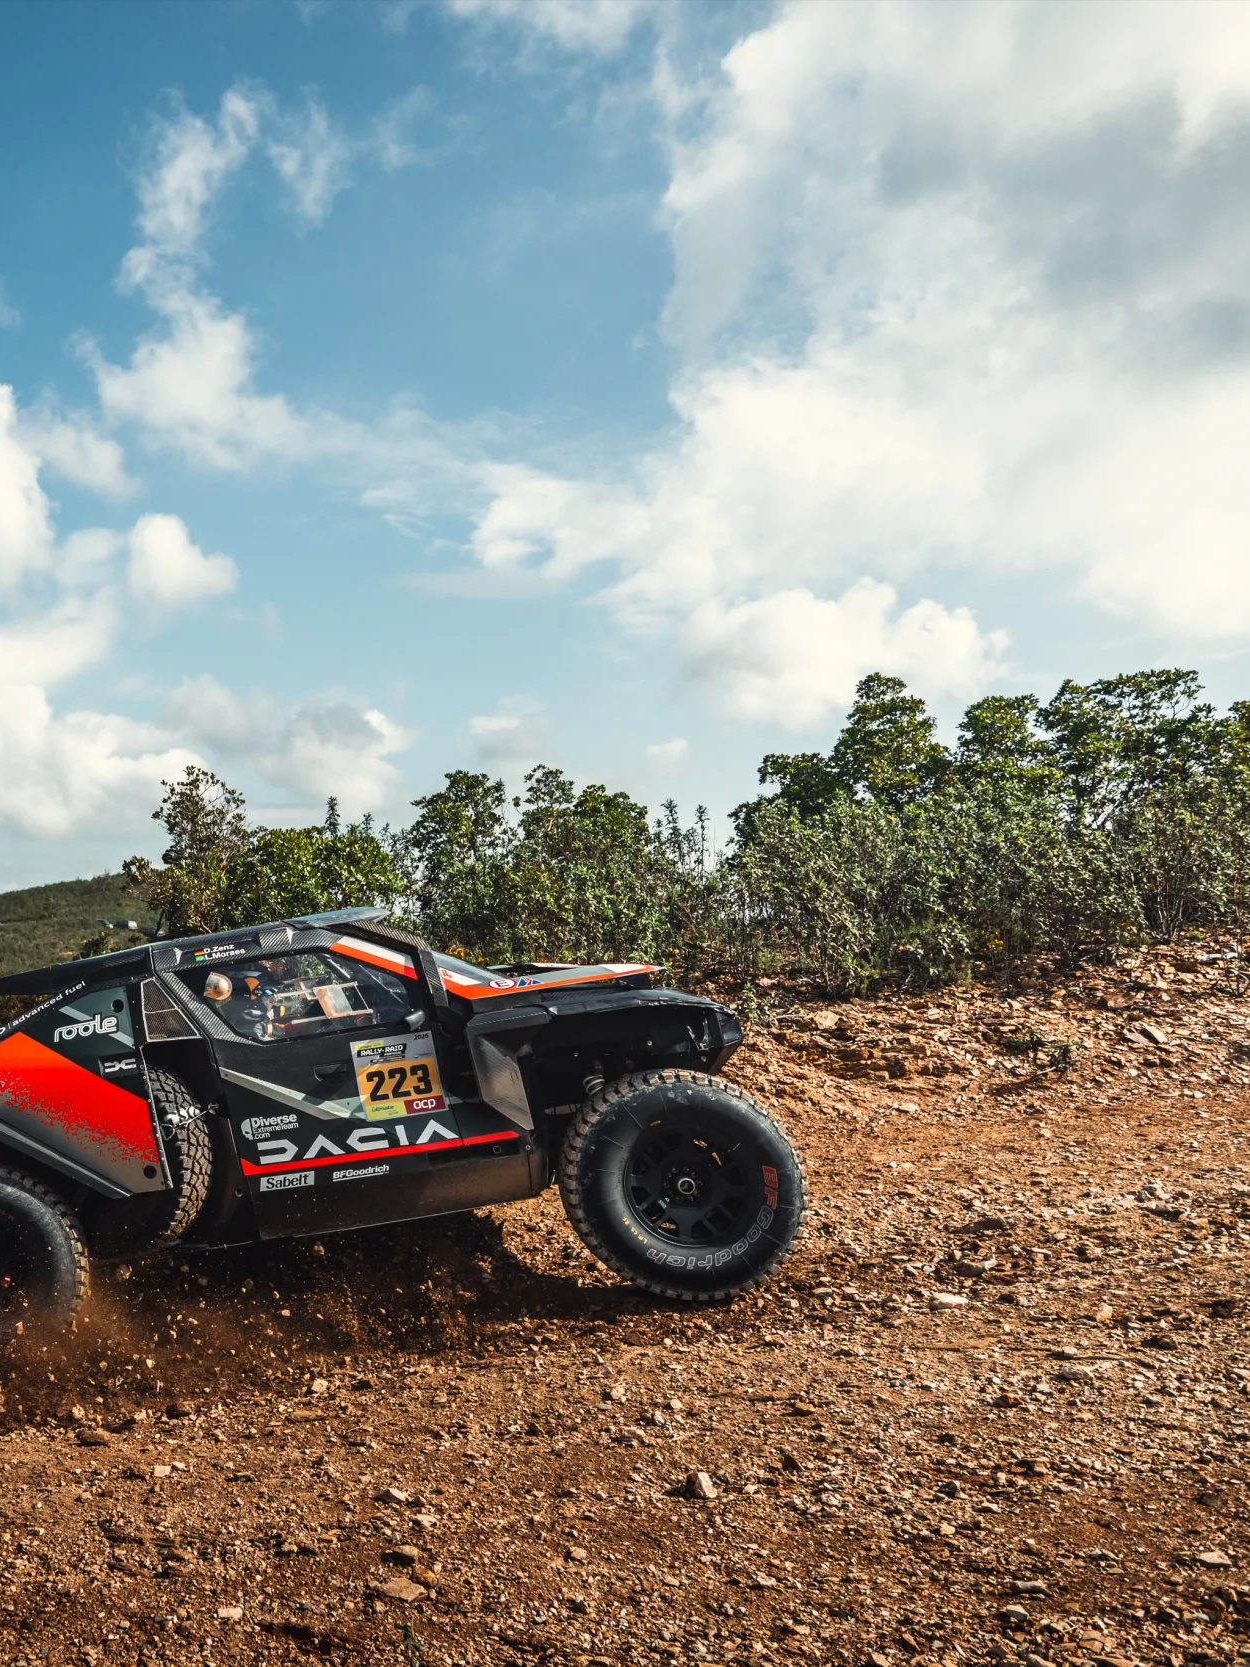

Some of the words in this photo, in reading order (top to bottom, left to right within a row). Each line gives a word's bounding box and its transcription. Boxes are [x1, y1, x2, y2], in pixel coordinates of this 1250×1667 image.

[203, 944, 235, 954] D.Zenz
[205, 948, 246, 960] L.Moraes
[12, 993, 63, 1026] advanced
[65, 980, 86, 996] fuel
[53, 1014, 118, 1043] roole
[360, 1044, 403, 1056] RALLY-RAID
[366, 1064, 433, 1101] 223
[413, 1099, 436, 1109] acp
[251, 1113, 298, 1128] Diverse
[253, 1122, 299, 1134] ExtremeTeam
[253, 1132, 271, 1140] .com
[257, 1119, 459, 1165] DACIA
[332, 1163, 390, 1180] BFGoodrich
[265, 1173, 310, 1190] Sabelt
[647, 1165, 779, 1270] BFGoodrich
